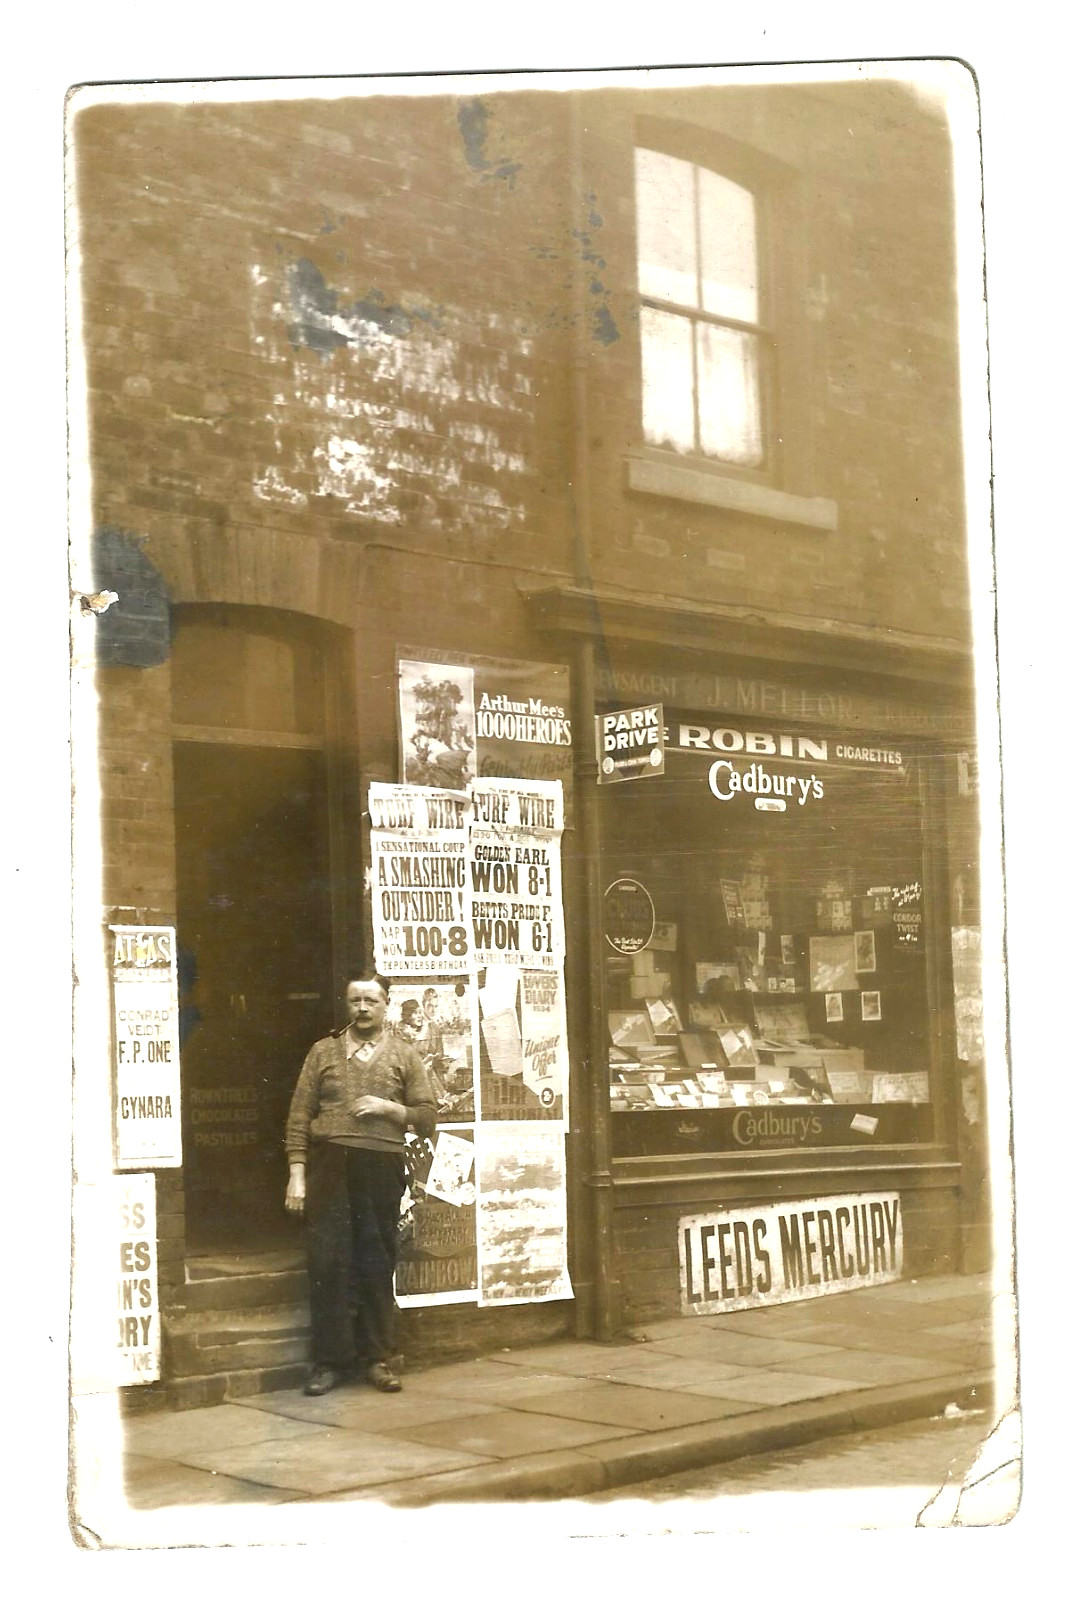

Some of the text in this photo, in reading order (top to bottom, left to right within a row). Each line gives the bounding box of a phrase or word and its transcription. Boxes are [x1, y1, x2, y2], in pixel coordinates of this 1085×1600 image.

[595, 668, 677, 698] EWSAGENT
[479, 692, 565, 719] Arthur Mee's
[603, 708, 659, 734] PARK
[603, 727, 659, 752] DRIVE
[679, 724, 828, 761] ROBIN
[836, 745, 902, 765] CIGARETTES
[708, 760, 824, 805] Cadbury's
[424, 798, 465, 830] WIRE
[472, 792, 555, 829] TURF WIRE
[378, 841, 441, 853] SENSATIONAL
[443, 842, 465, 853] COUP
[474, 844, 550, 865] GOLDEN EARL
[378, 856, 466, 889] A SMASHING
[470, 861, 552, 896] WON 8-1
[472, 918, 553, 952] WON 6-1
[382, 943, 402, 956] WON
[525, 990, 557, 1005] DIARY
[118, 1009, 170, 1022] CONRAD
[147, 1040, 171, 1064] ONE
[121, 1095, 173, 1119] CYNARA
[732, 1110, 823, 1146] Cadbury's
[684, 1199, 899, 1304] LEEDS MERCURY
